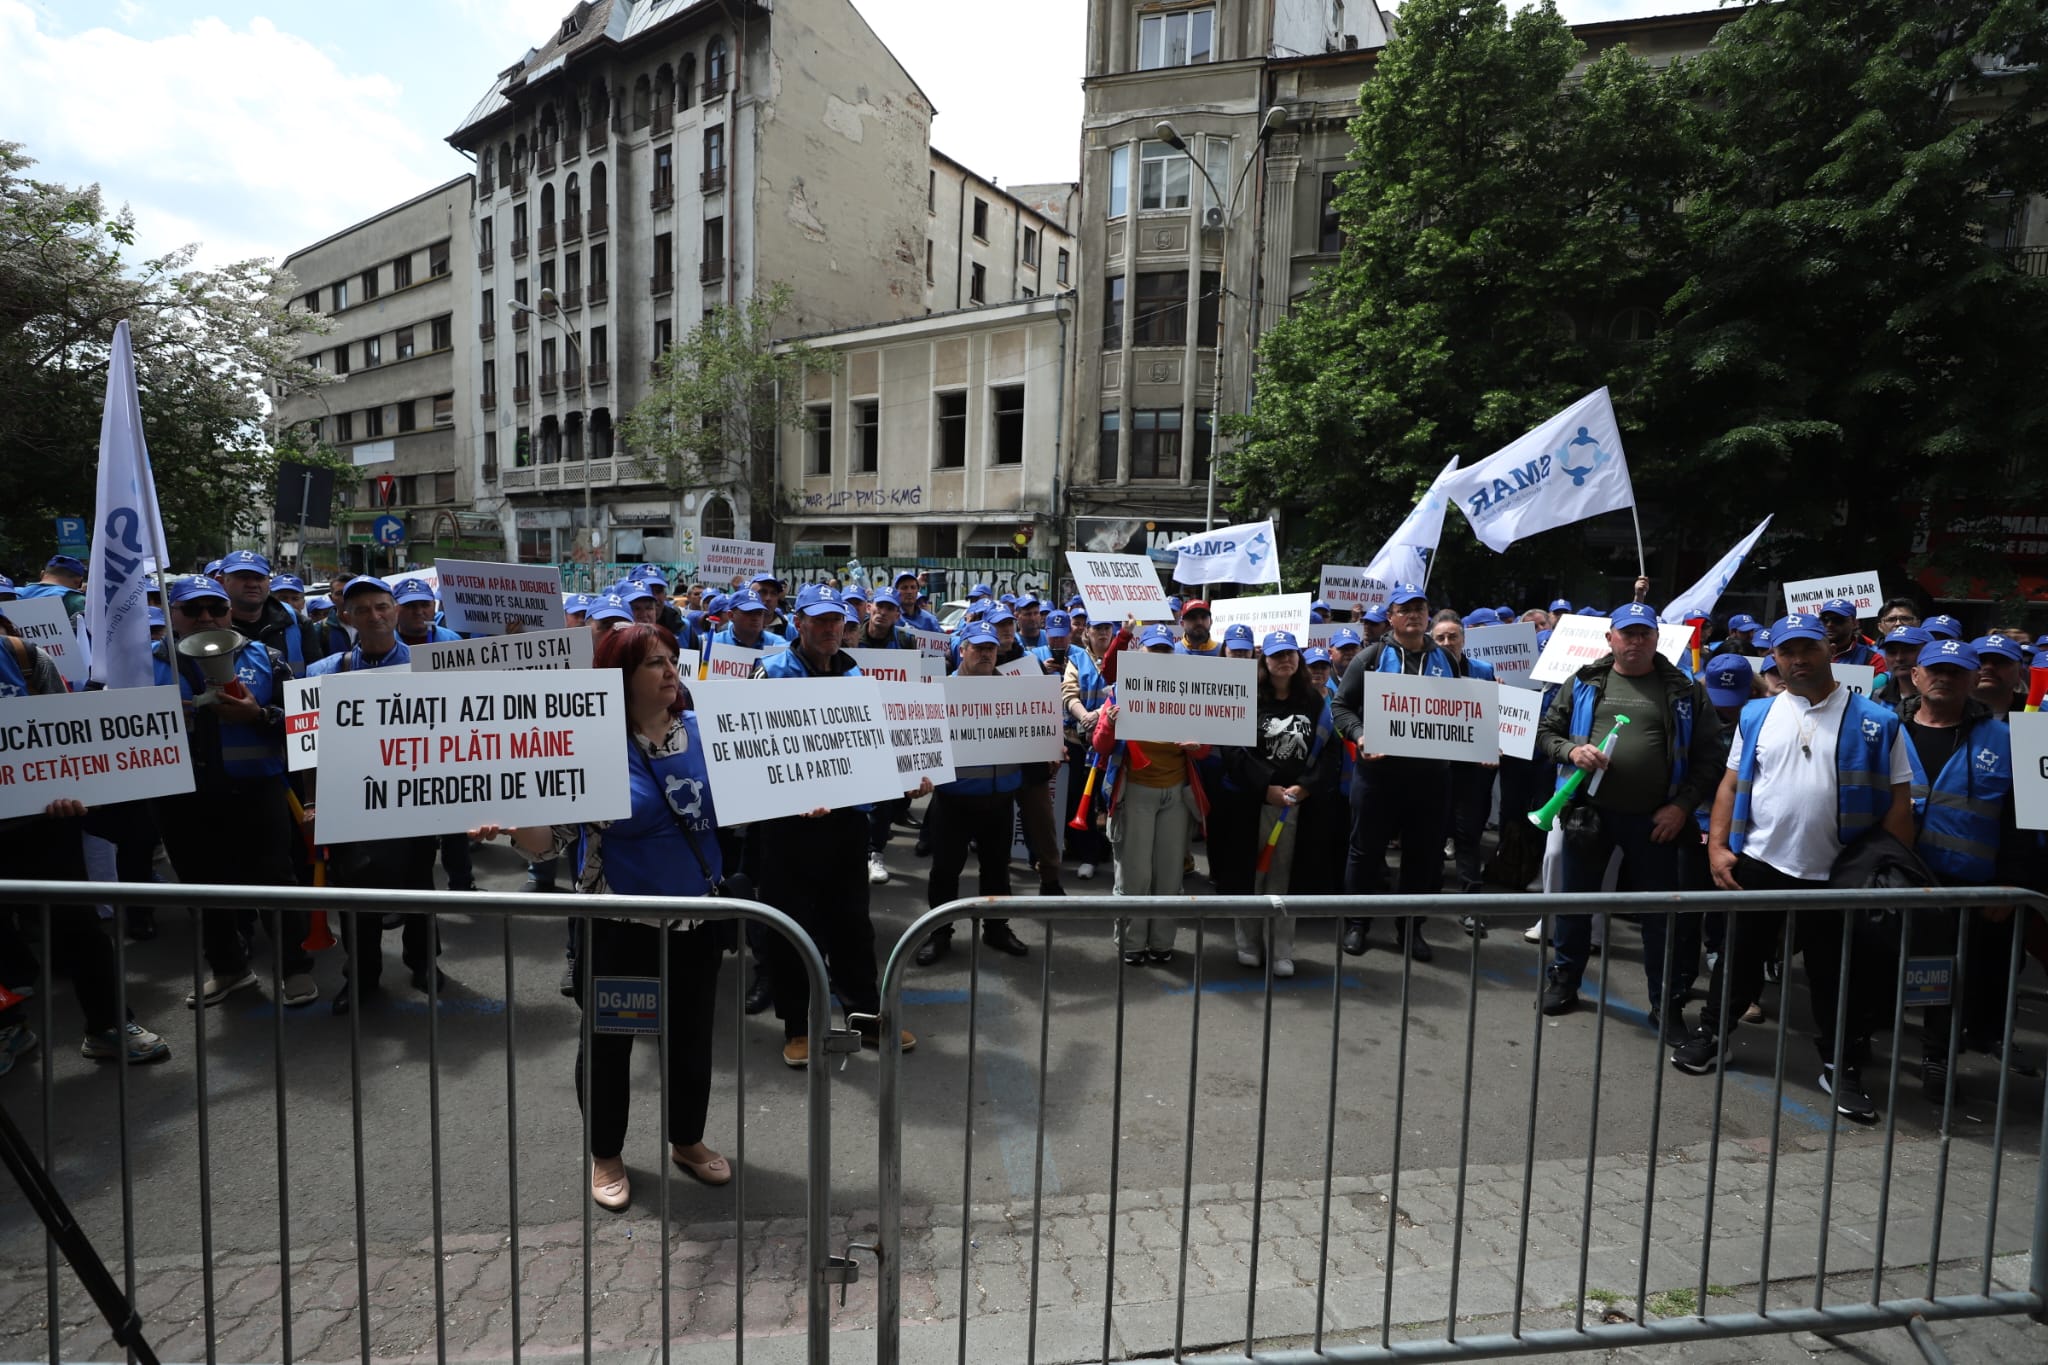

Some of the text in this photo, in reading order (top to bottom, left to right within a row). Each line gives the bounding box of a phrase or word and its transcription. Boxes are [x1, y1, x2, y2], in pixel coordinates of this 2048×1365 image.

[63, 520, 78, 537] P
[1087, 561, 1142, 578] TRAI DECENT
[442, 574, 454, 586] NU
[456, 575, 485, 590] PUTEM
[520, 580, 557, 594] DIGURILE
[1325, 576, 1350, 587] MUNCIM
[455, 592, 549, 611] MUNCIND PE SALARIUL
[1085, 585, 1162, 605] PREȚURI DECENTE!
[1327, 590, 1336, 599] NU
[1791, 590, 1824, 603] MUNCIM
[1857, 583, 1875, 595] DAR
[464, 609, 545, 627] MINIM PE ECONOMIE
[432, 637, 571, 670] DIANA CÂT TU STAI
[1125, 678, 1140, 690] NOI
[1143, 677, 1153, 692] ÎN
[1156, 680, 1176, 693] FRIG
[1180, 681, 1188, 696] ȘI
[336, 692, 608, 730] CE TĂIAȚI AZI DIN BUGET
[962, 703, 992, 719] PUȚINI
[995, 702, 1013, 719] ȘEFI
[1016, 702, 1027, 715] LA
[1128, 698, 1246, 721] VOI ÎN BIROU CU INVENȚII!
[1382, 692, 1482, 721] TĂIAȚI CORUPȚIA
[100, 711, 178, 741] BOGAȚI
[295, 718, 309, 730] NU
[717, 712, 763, 735] NE-AȚI
[765, 708, 818, 729] INUNDAT
[820, 705, 871, 725] LOCURILE
[950, 725, 1057, 742] AI MULȚI OAMENI PE BARAJ
[1390, 720, 1474, 743] NU VENITURILE
[380, 726, 574, 772] VEȚI PLĂTI MÂINE
[712, 728, 885, 762] DE MUNCĂ CU INCOMPETENȚII
[23, 753, 110, 782] CETĂȚENI
[116, 745, 180, 771] SĂRACI
[768, 757, 853, 784] DE LA PARTID!
[363, 768, 585, 810] ÎN PIERDERI DE VIEȚI
[1906, 970, 1949, 985] DGJMB
[598, 992, 657, 1010] DGJMB
